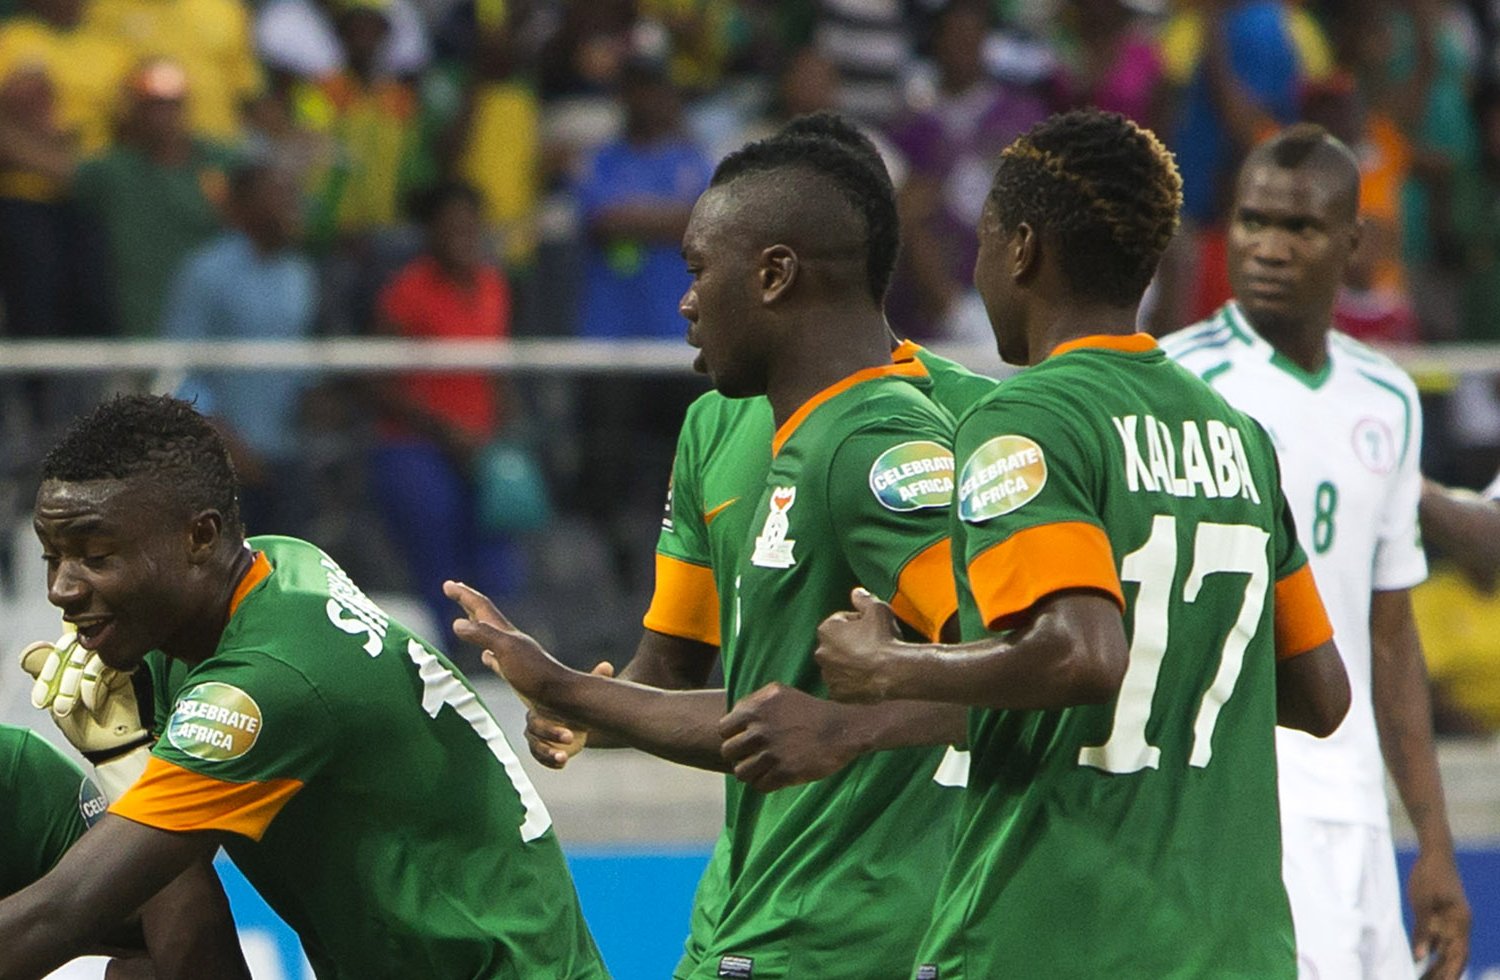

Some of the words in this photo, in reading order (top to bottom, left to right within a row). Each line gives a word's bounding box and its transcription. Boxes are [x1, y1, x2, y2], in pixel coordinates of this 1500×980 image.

[959, 448, 1039, 501] CELEBRATE
[1112, 415, 1261, 505] KALABA
[898, 477, 954, 502] AFRICA
[970, 477, 1028, 513] AFRICA
[1312, 480, 1339, 555] 8
[1078, 515, 1271, 774] 17
[177, 722, 234, 752] AFRICA
